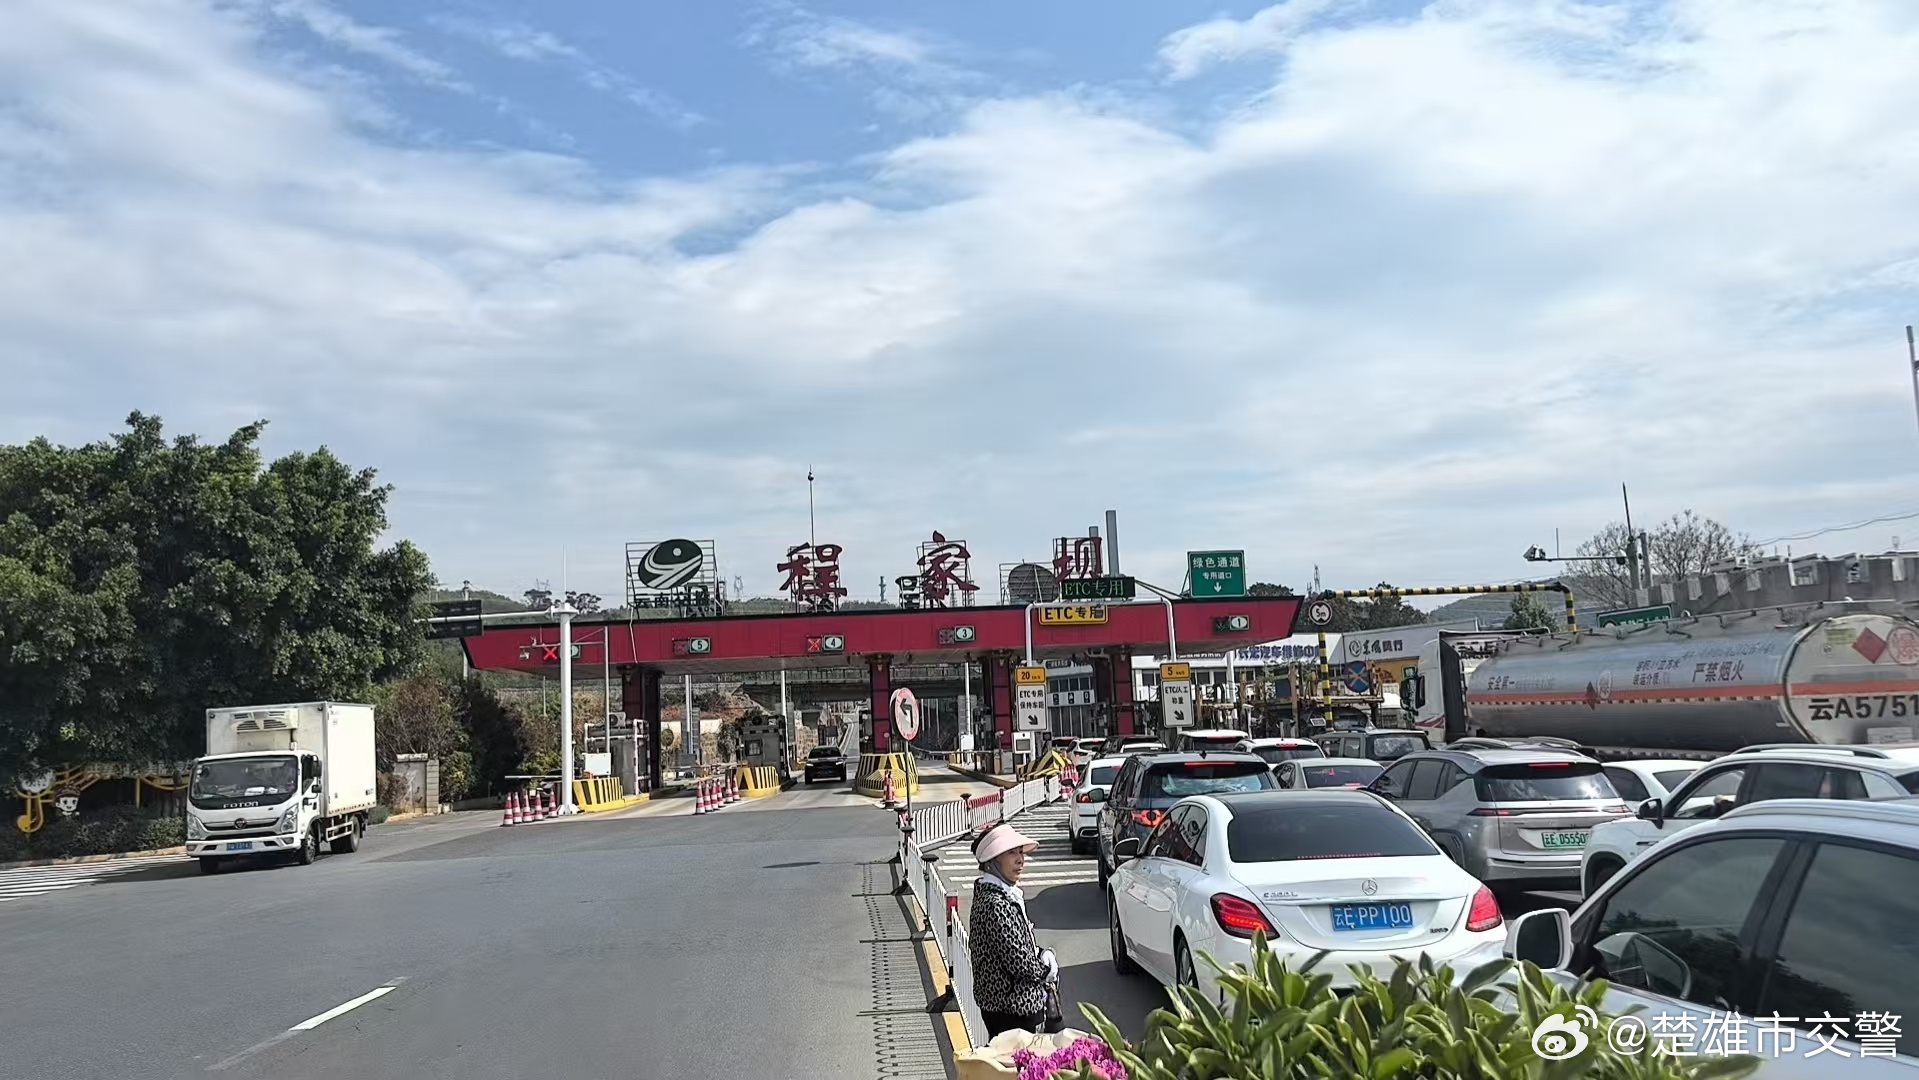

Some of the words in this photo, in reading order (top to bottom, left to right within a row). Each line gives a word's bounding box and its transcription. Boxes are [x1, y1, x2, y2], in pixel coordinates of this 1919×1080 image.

[777, 531, 1103, 600] 程家坝
[1192, 556, 1240, 568] 绿色通道
[1064, 579, 1124, 597] ETC专用
[962, 628, 968, 638] 3
[696, 640, 703, 650] 5
[830, 637, 837, 649] 4
[1021, 671, 1030, 680] 20
[1167, 666, 1173, 676] 5
[1692, 660, 1744, 682] 严禁烟火
